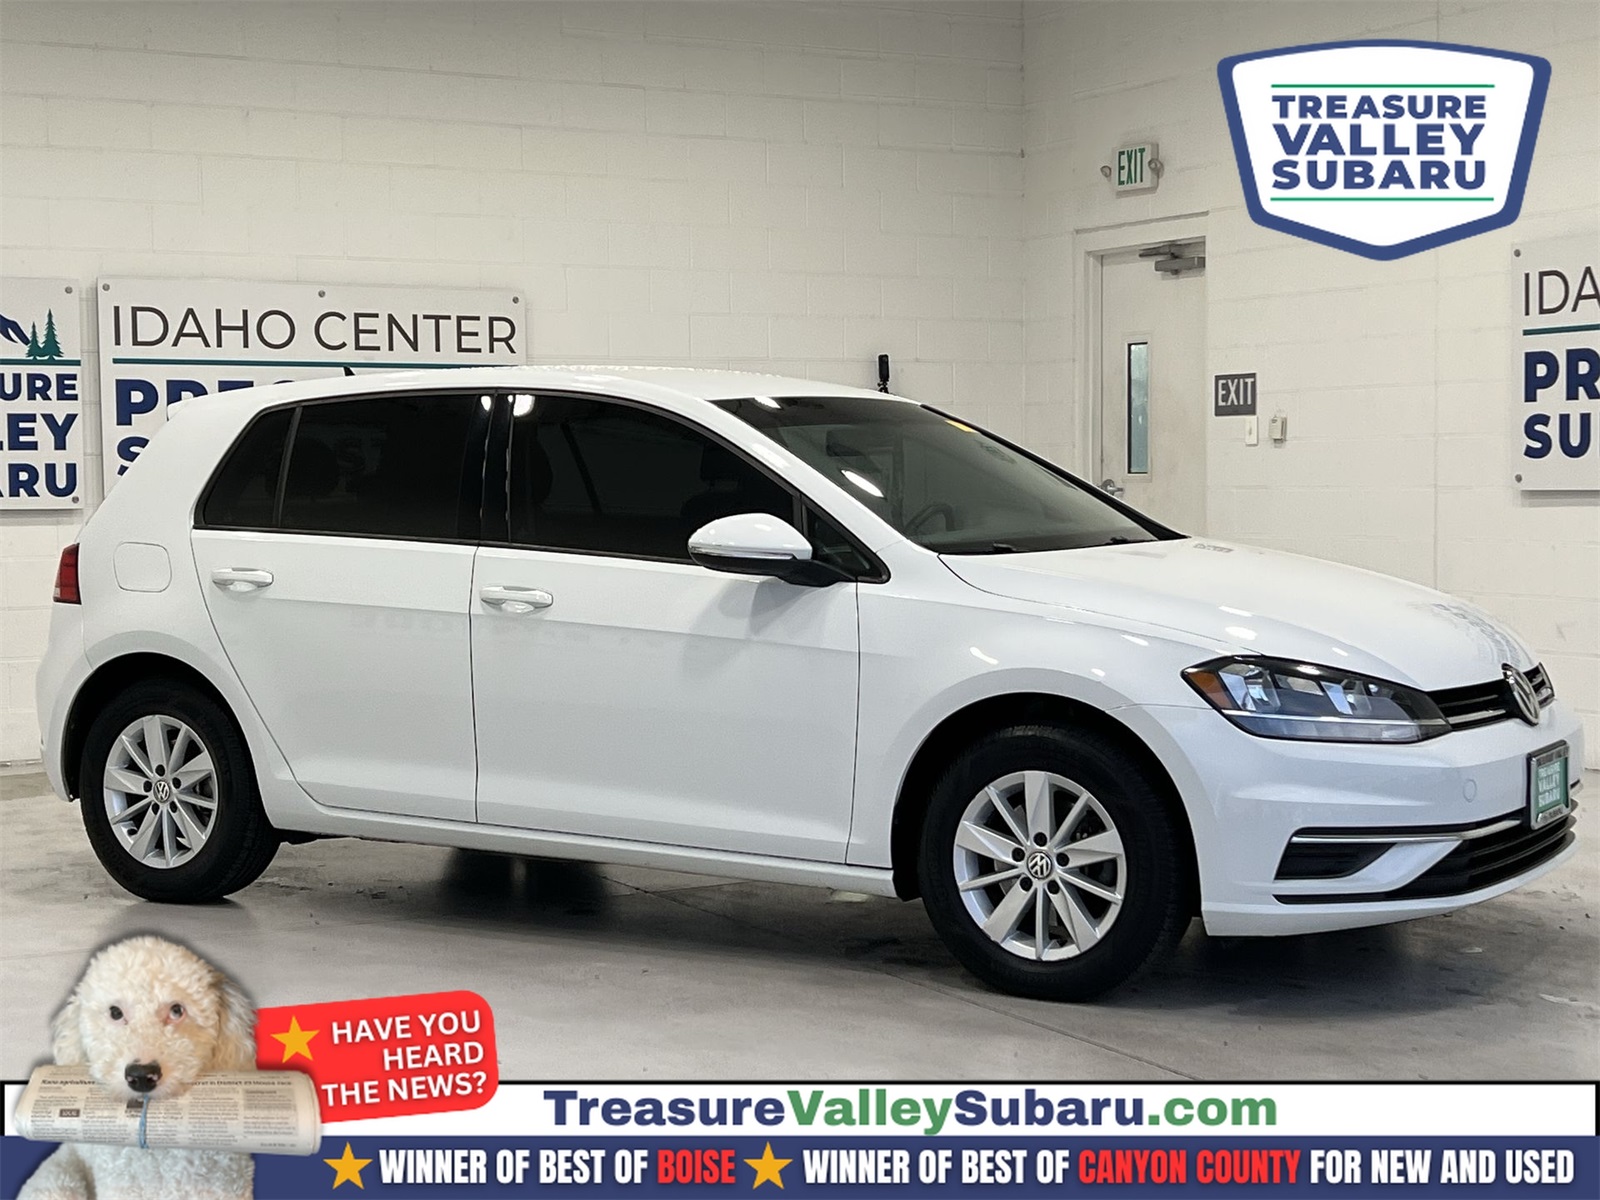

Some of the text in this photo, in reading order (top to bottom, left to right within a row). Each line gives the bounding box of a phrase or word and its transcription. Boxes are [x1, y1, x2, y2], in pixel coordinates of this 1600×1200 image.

[1117, 147, 1146, 186] EXIT
[113, 305, 517, 354] IDAHO CENTER
[1217, 377, 1255, 407] EXIT
[0, 413, 79, 451] EY
[1523, 412, 1600, 459] SU
[0, 462, 77, 498] RU
